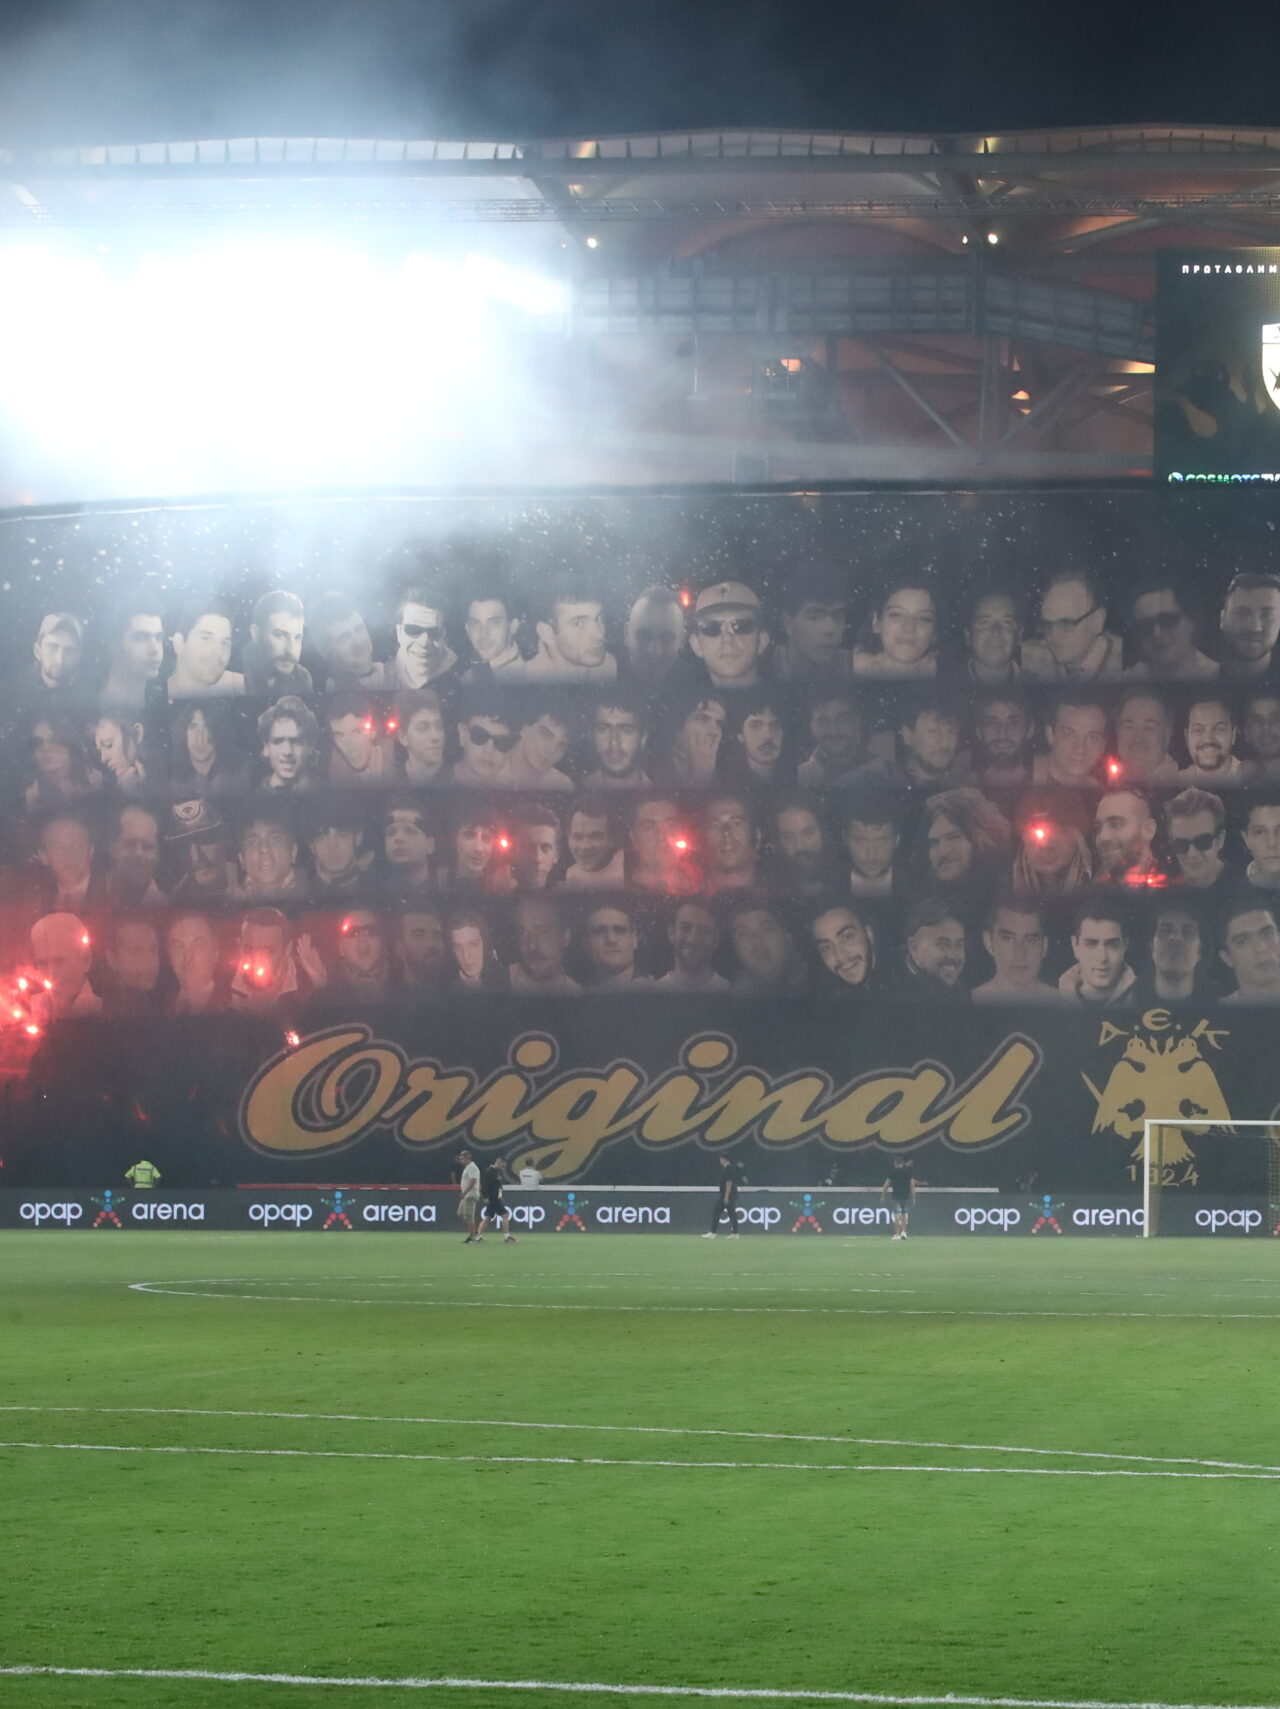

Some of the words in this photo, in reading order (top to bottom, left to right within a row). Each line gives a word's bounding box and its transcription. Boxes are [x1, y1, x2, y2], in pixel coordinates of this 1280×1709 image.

[243, 1025, 1040, 1182] Original
[19, 1202, 83, 1226] opap
[132, 1202, 205, 1221] arena
[248, 1203, 313, 1228] opap
[362, 1204, 436, 1222] arena
[597, 1206, 671, 1224] arena
[954, 1207, 1021, 1232] opap
[1195, 1209, 1263, 1233] opap
